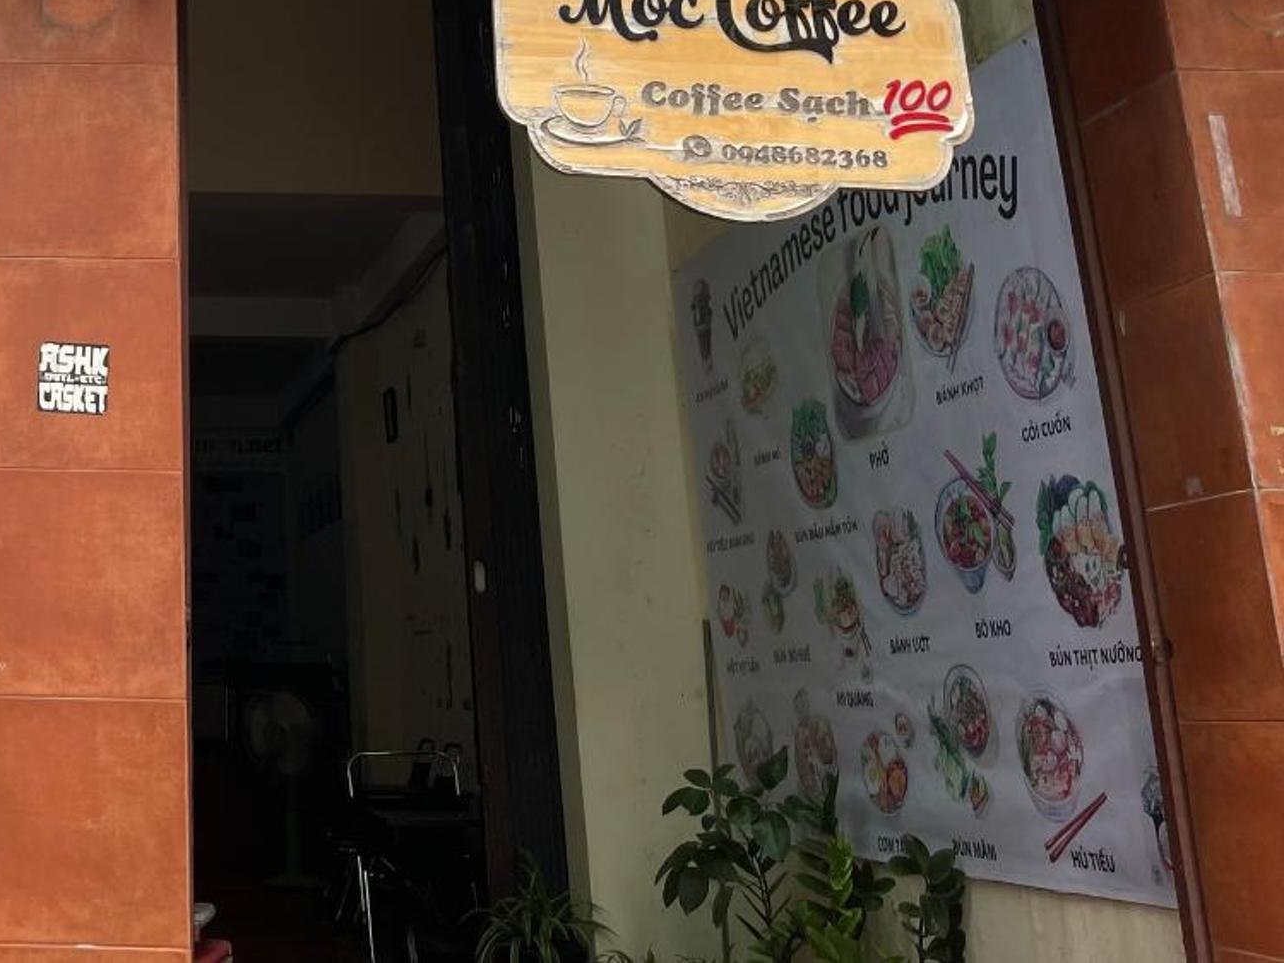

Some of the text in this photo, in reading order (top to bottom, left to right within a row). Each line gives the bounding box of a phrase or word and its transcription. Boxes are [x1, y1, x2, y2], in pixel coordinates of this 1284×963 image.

[641, 79, 953, 124] Coffee Sạch 100
[722, 203, 836, 339] Vietnamese
[1049, 643, 1072, 668] BÚN
[1073, 648, 1098, 672] THỊT
